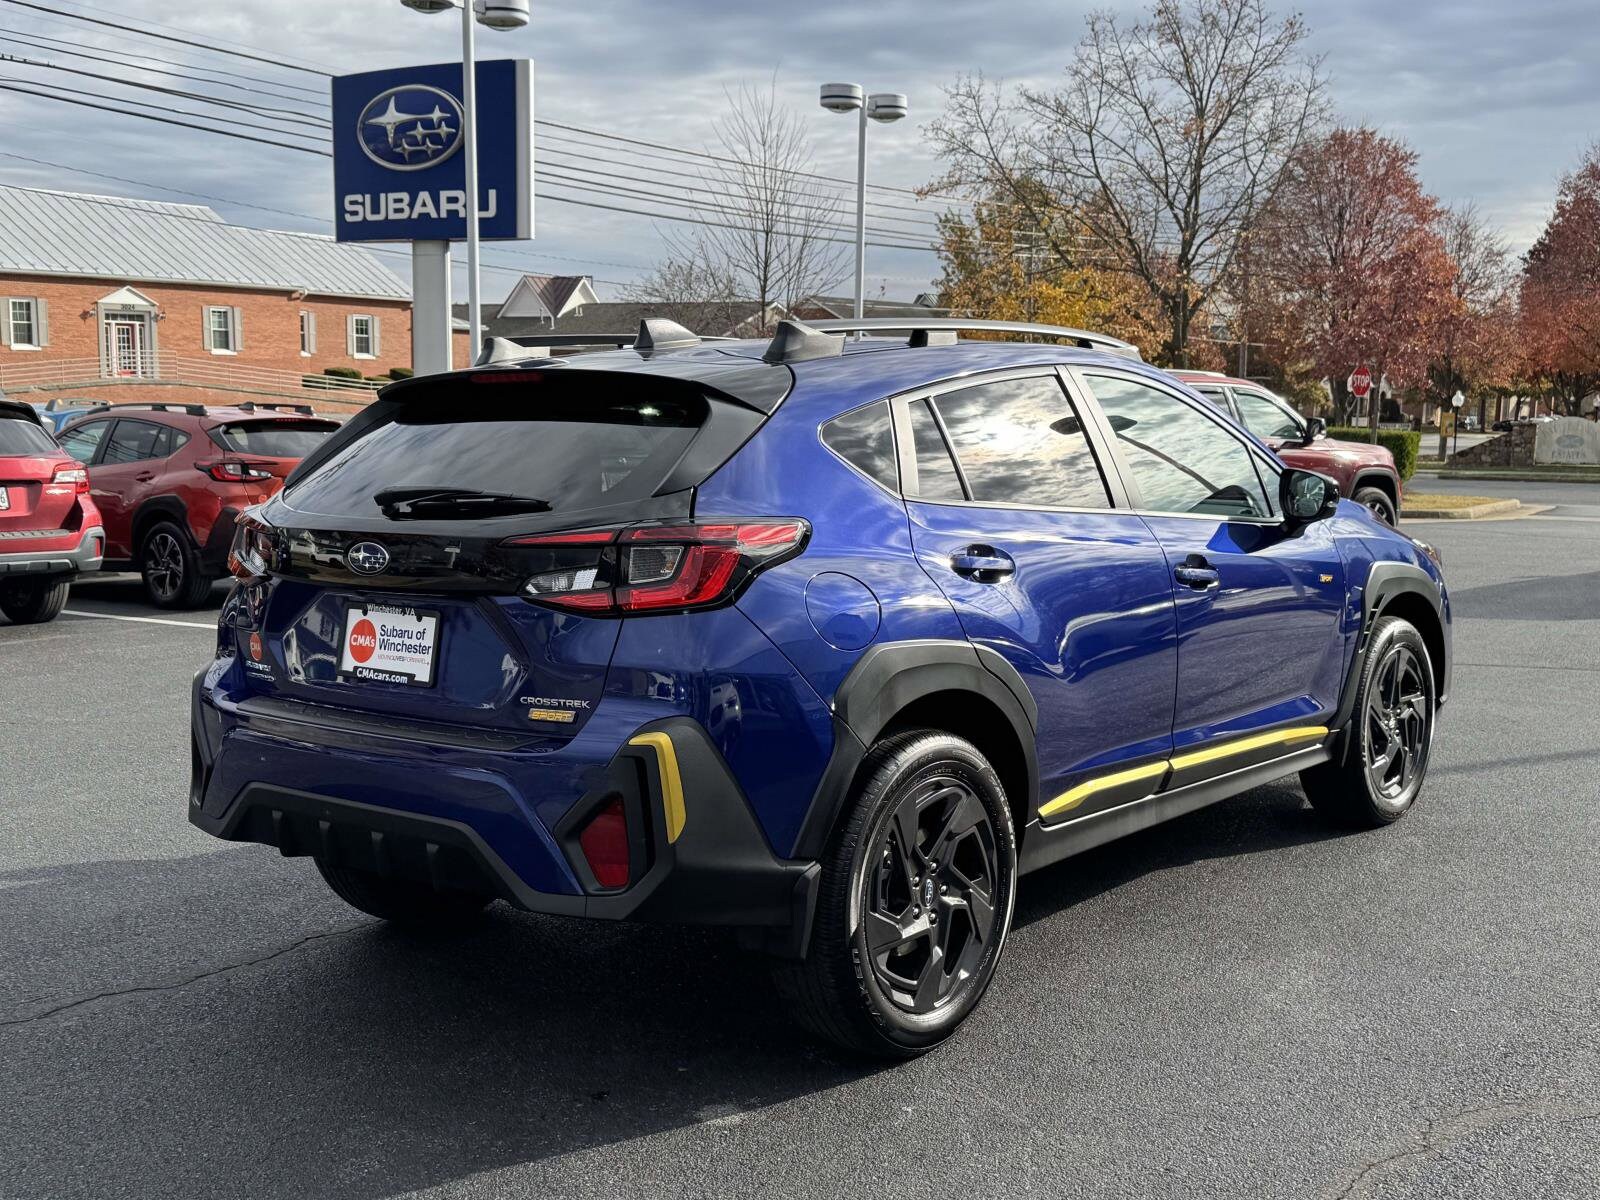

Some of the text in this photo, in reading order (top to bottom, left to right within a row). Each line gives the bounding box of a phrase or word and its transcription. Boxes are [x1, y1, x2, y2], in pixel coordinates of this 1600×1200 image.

[1352, 374, 1370, 387] STOP
[406, 607, 416, 616] VA
[380, 624, 427, 640] Subaru of
[351, 633, 375, 648] CMA's
[378, 638, 432, 655] Winchester
[356, 667, 408, 684] CMAcars.com
[519, 696, 591, 709] CROSSTREK
[531, 711, 572, 721] SPORT
